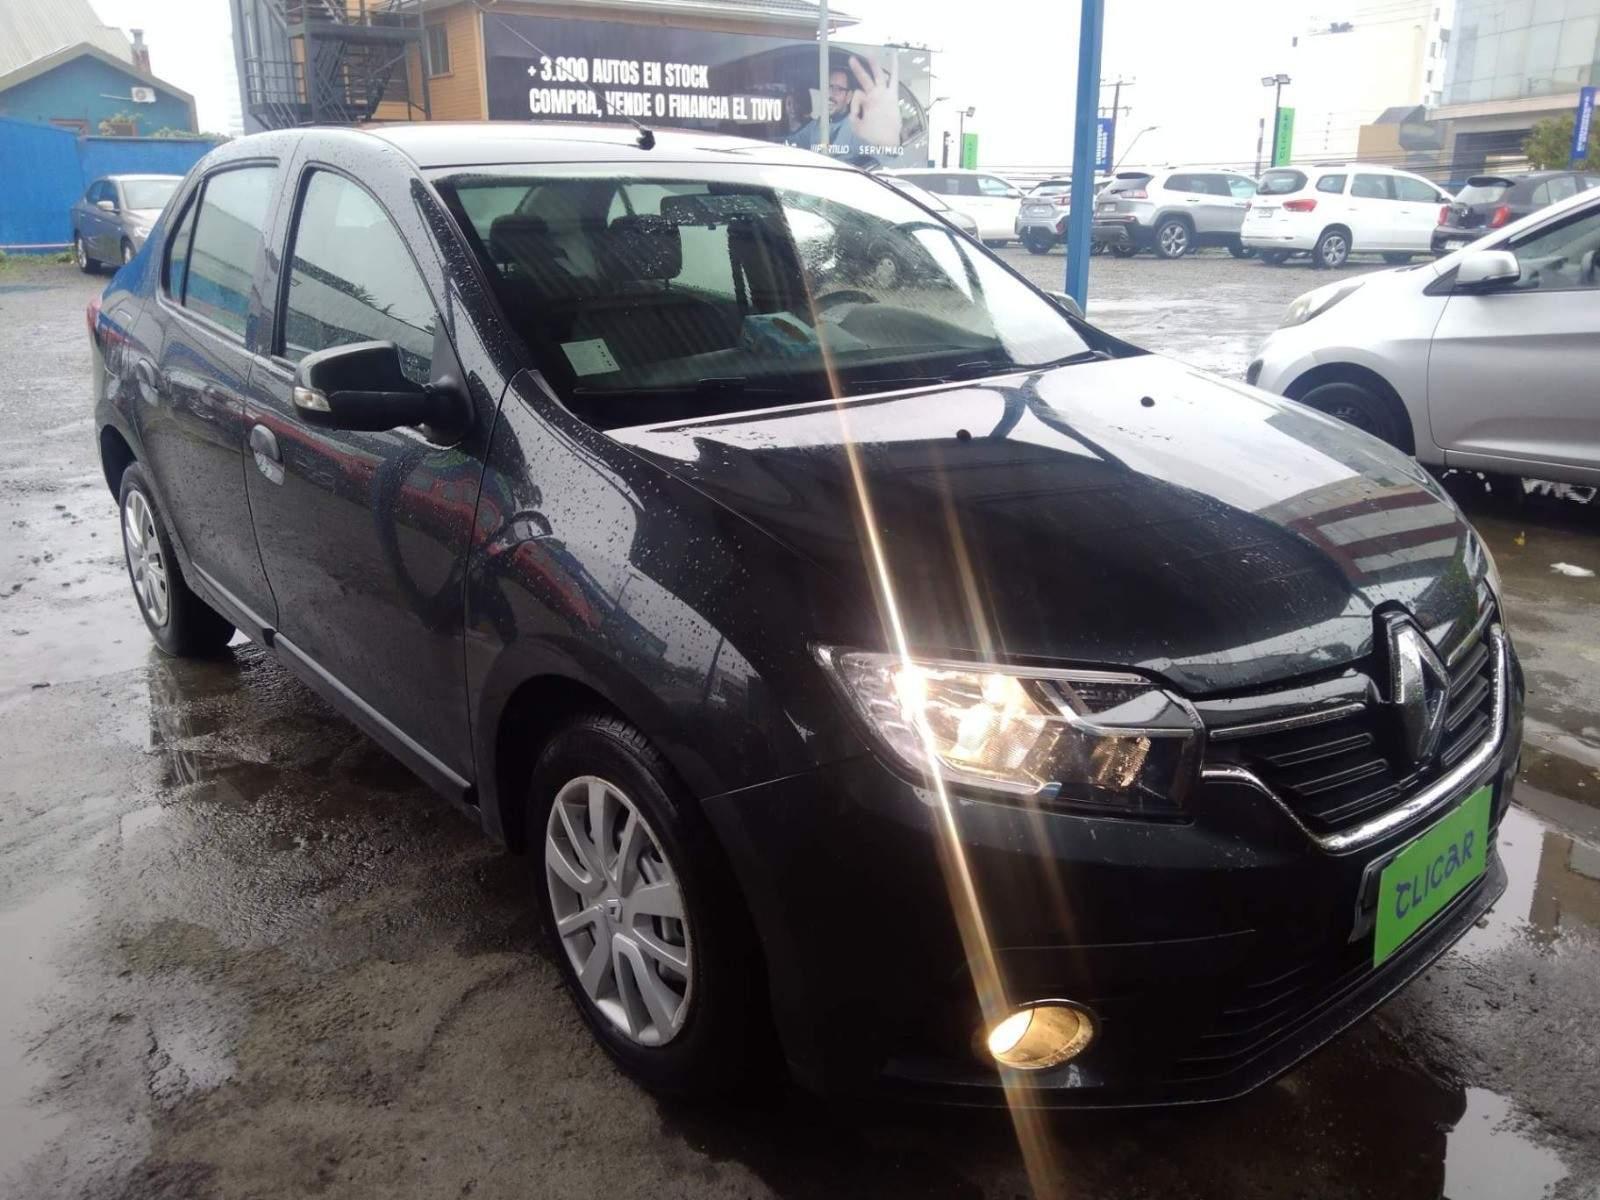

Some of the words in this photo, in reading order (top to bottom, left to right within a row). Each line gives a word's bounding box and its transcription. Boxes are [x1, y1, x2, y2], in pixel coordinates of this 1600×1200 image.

[527, 65, 537, 77] +
[540, 55, 589, 83] 3.000
[592, 58, 640, 85] AUTOS
[643, 61, 661, 86] EN
[664, 62, 709, 89] STOCK
[529, 88, 602, 118] COMPRA,
[605, 91, 652, 117] VENDE
[655, 93, 665, 117] O
[668, 94, 730, 120] FINANCIA
[732, 97, 748, 120] EL
[750, 98, 783, 122] TUYO
[859, 144, 904, 156] SERVIMAQ
